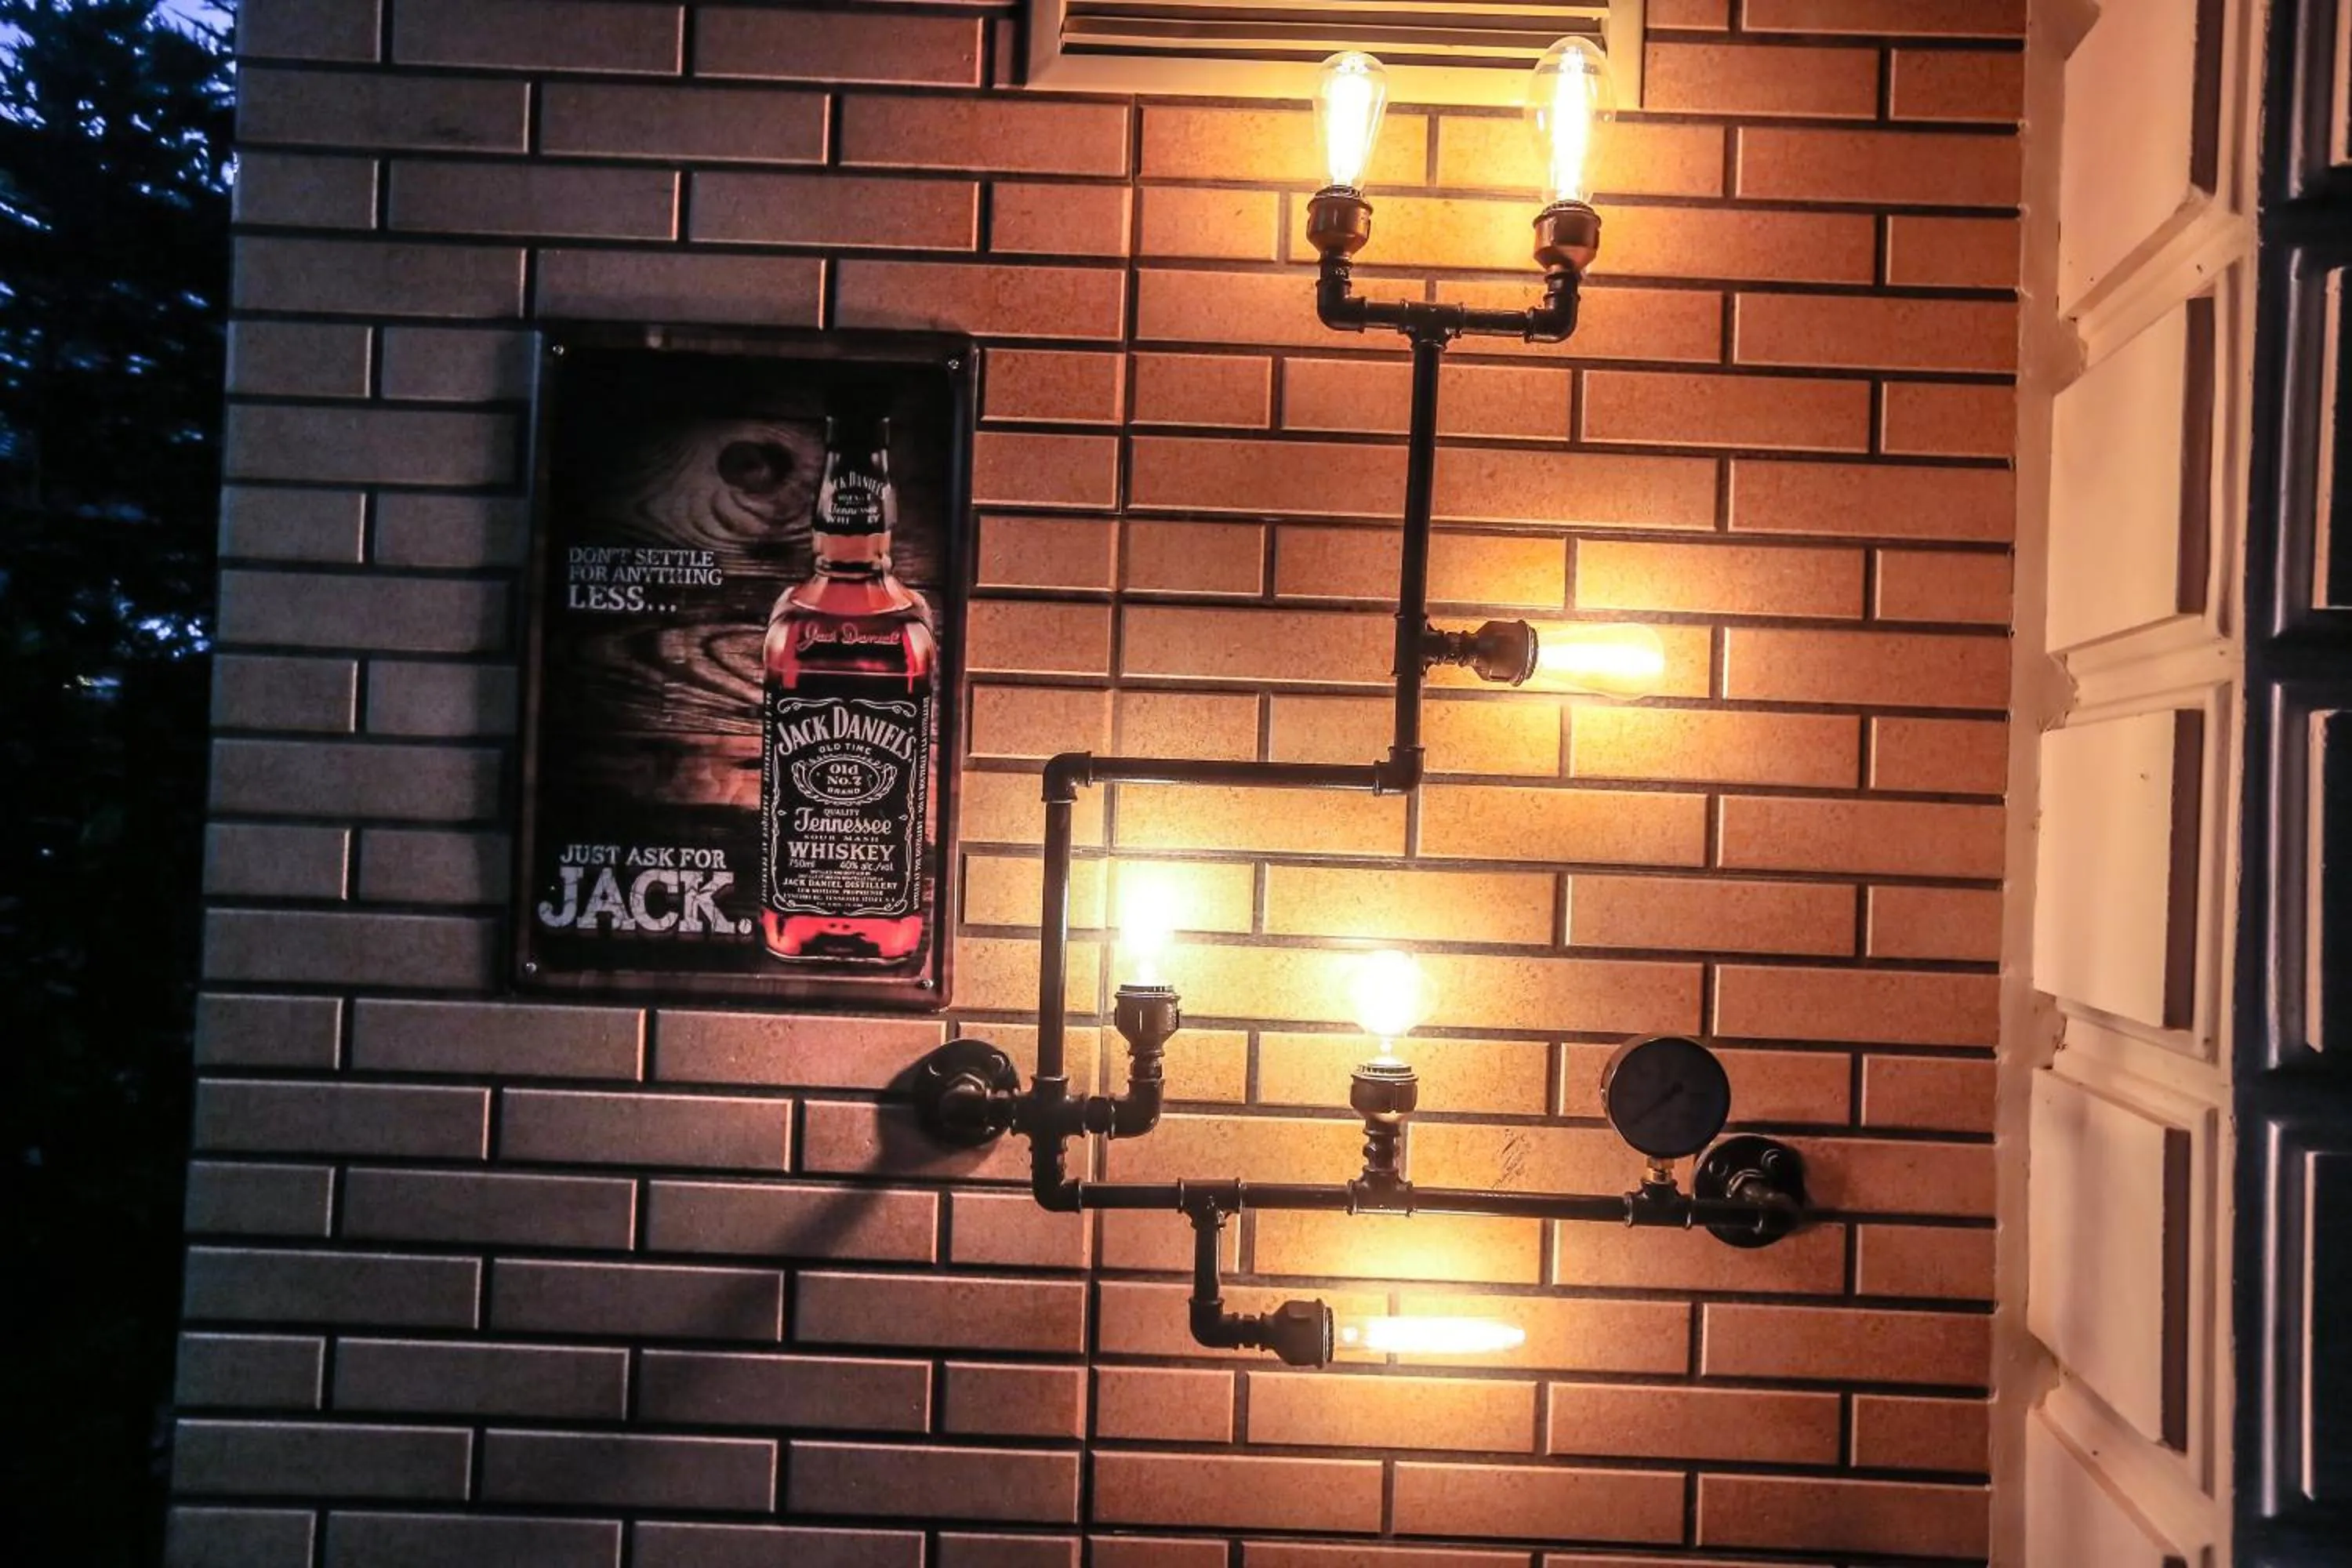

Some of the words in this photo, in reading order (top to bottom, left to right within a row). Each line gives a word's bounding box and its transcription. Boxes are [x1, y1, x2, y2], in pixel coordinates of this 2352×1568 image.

[568, 547, 627, 564] DON'T
[634, 549, 714, 567] SETTLE
[568, 565, 608, 582] FOR
[612, 565, 723, 586] ANYTHING
[568, 584, 677, 612] LESS...
[778, 714, 831, 755] JACK
[819, 743, 840, 753] OLD
[846, 742, 872, 755] TIME
[829, 764, 858, 775] Old
[794, 807, 892, 835] Tennessee
[823, 808, 860, 817] QUALITY
[560, 844, 620, 863] JUST
[626, 847, 674, 867] ASK
[679, 848, 728, 869] FOR
[787, 840, 896, 862] WHISKEY
[789, 858, 815, 868] 750ml
[782, 877, 806, 887] JACK
[808, 879, 843, 888] DANIEL
[844, 880, 898, 890] DISTILLERY
[538, 866, 753, 934] JACK.
